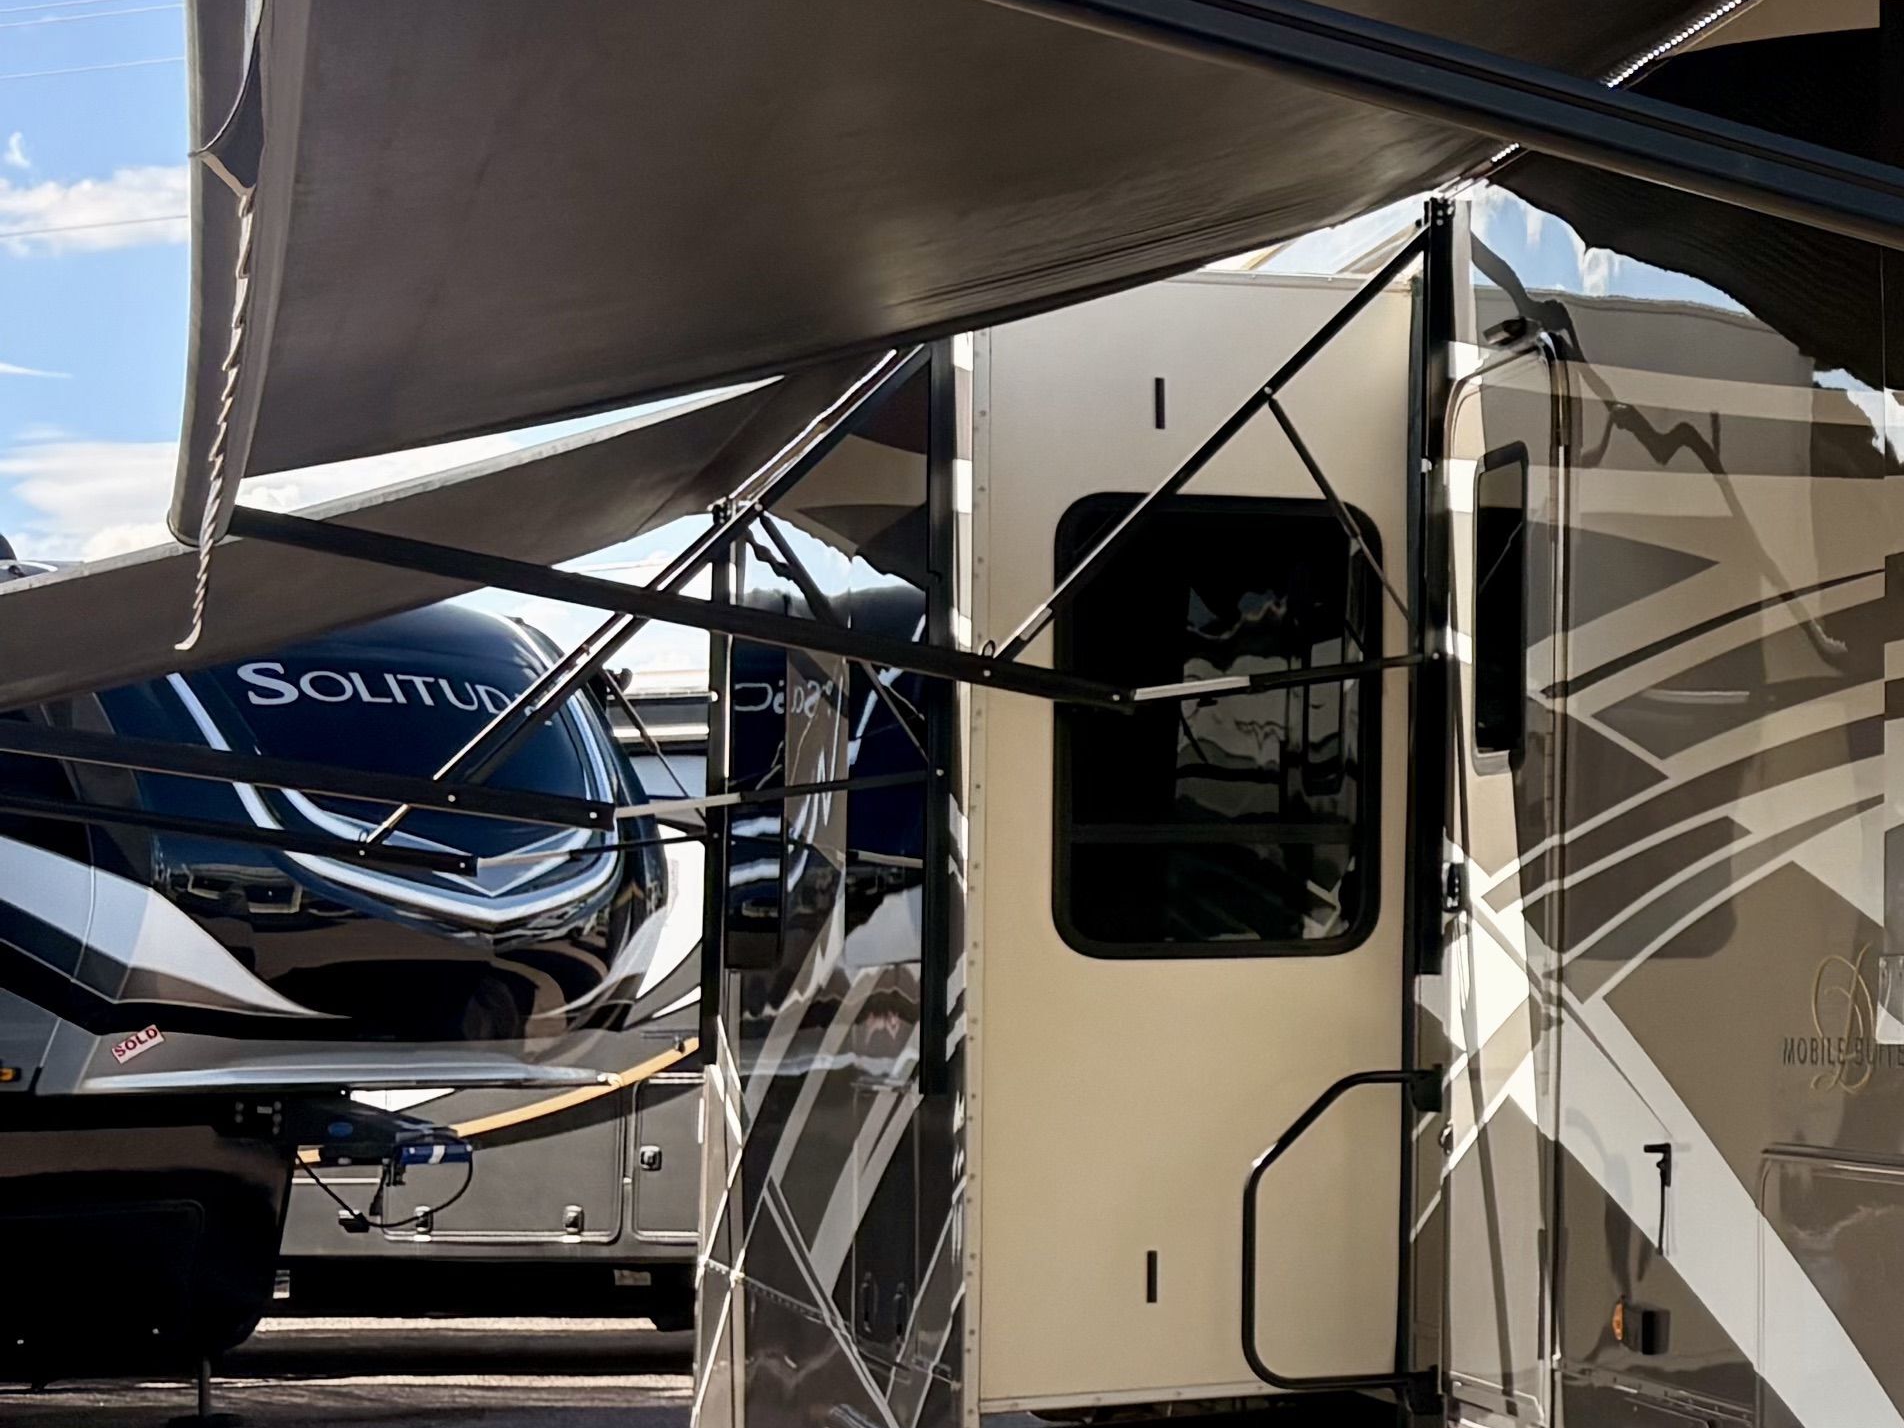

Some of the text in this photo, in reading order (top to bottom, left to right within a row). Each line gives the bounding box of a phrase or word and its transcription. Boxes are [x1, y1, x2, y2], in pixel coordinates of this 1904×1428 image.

[237, 661, 546, 726] SOLITUD
[114, 1027, 158, 1057] SOLD
[1783, 1036, 1846, 1066] MOBILE
